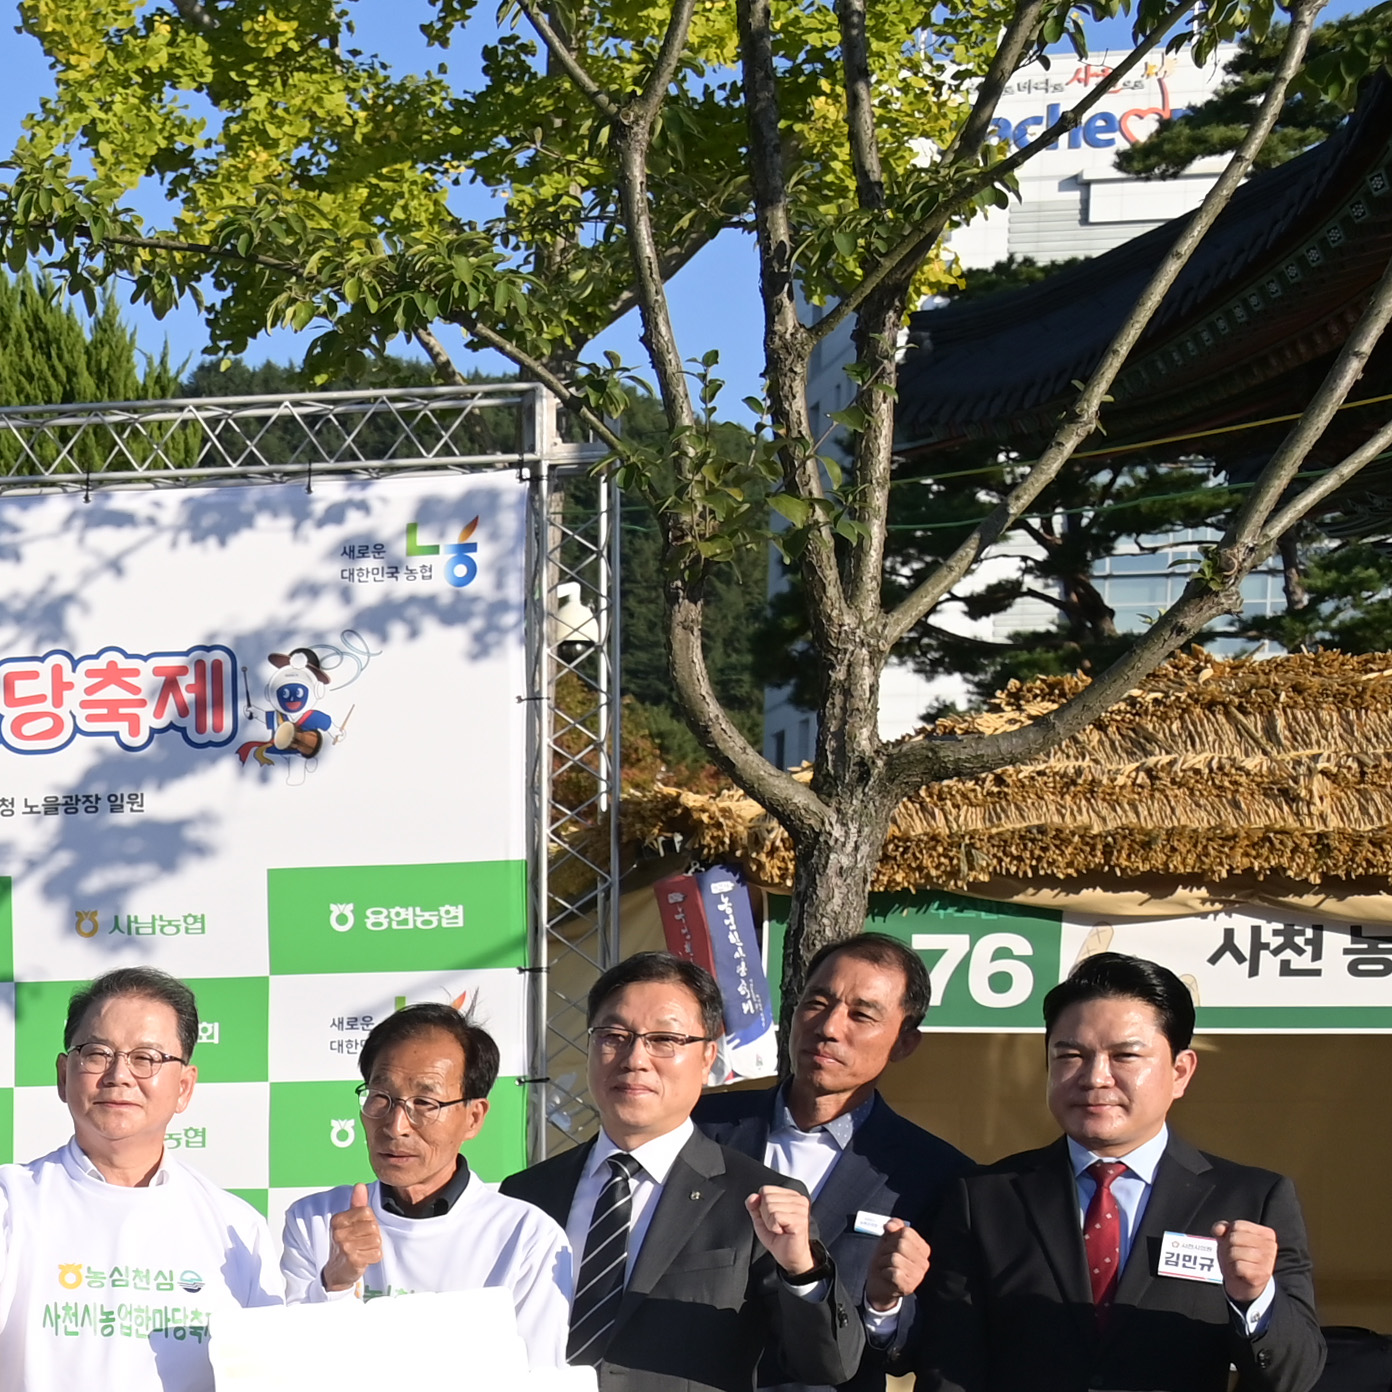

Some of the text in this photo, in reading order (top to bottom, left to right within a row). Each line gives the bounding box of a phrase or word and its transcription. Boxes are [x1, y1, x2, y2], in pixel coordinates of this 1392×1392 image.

[340, 543, 386, 560] 새로운
[341, 564, 433, 583] 대한민국 농협
[21, 794, 101, 816] 노을광장
[107, 791, 146, 814] 일원
[108, 913, 206, 936] 사남농협
[364, 904, 464, 931] 용현농협
[1206, 923, 1323, 979] 사천
[911, 931, 1034, 1008] 76
[330, 1015, 375, 1032] 새로운
[1164, 1251, 1215, 1273] 김민규
[85, 1265, 174, 1292] 농심천심
